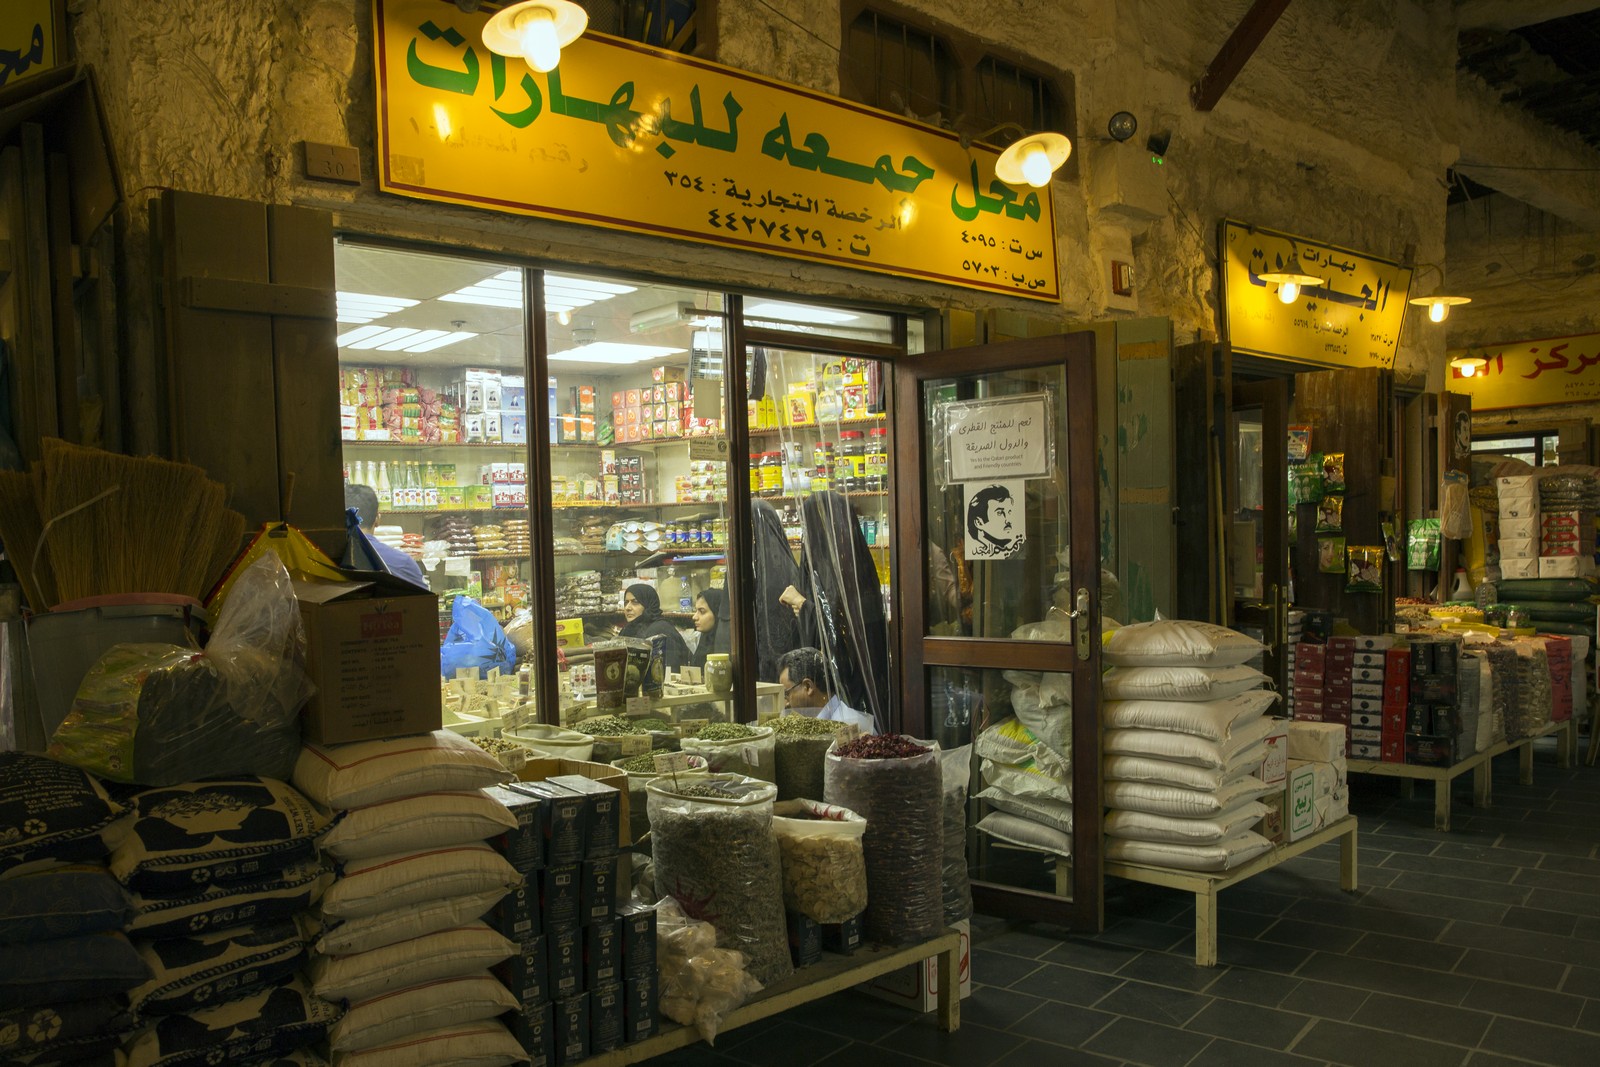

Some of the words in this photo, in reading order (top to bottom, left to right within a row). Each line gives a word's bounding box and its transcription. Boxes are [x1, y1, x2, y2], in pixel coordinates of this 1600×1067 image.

[663, 170, 705, 193] ٣٥٤
[707, 208, 827, 248] ٤٤٢٧٤٢٩
[960, 229, 997, 248] ٤٠٩٥
[962, 259, 1000, 278] ٥٧٠٣
[1303, 248, 1357, 277] بهارات
[990, 418, 1014, 435] للمنتج
[1018, 416, 1032, 432] نعم
[965, 440, 997, 453] الصديقة
[999, 438, 1029, 451] والدول
[989, 534, 1023, 557] تميم
[1294, 795, 1312, 817] ربيع
